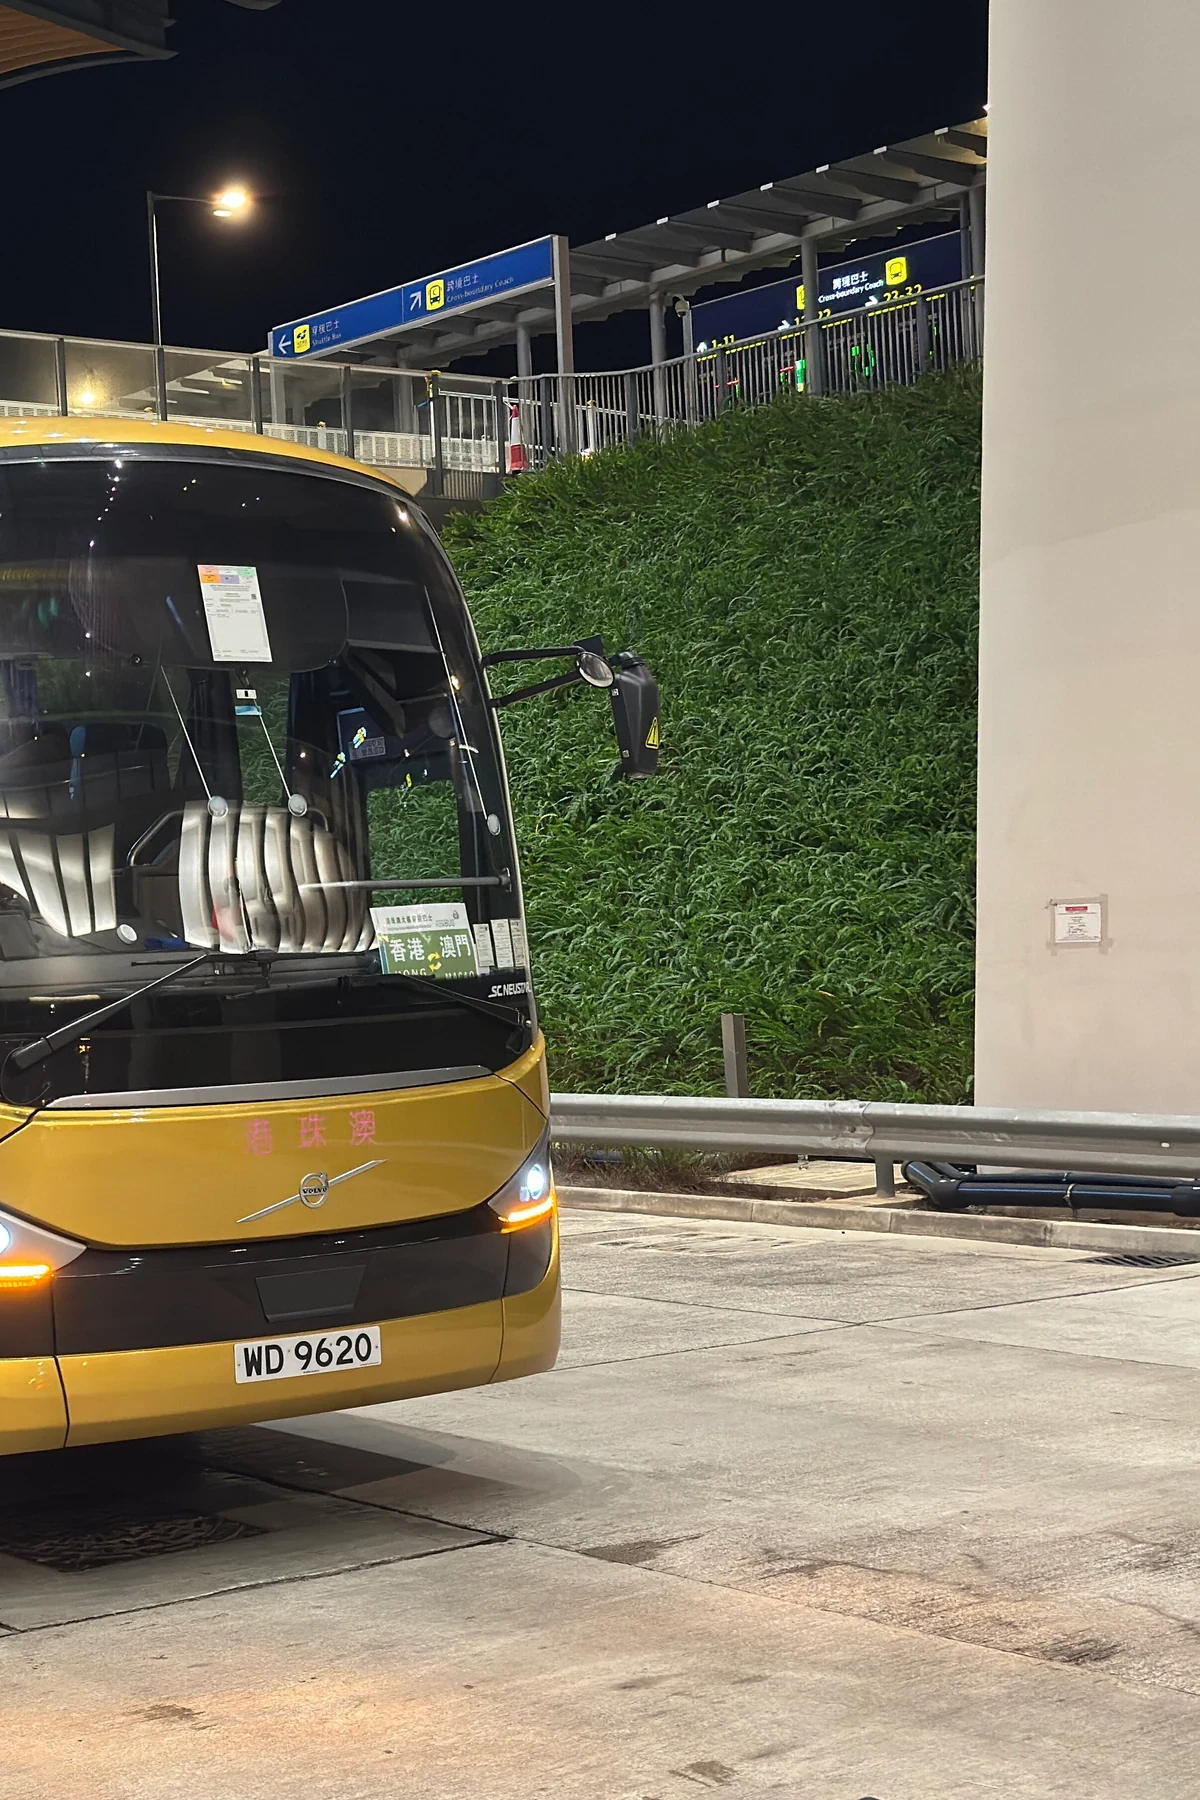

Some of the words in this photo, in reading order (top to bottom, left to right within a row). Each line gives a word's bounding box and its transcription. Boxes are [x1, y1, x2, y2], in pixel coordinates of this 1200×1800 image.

[446, 283, 493, 303] Cross-boundary
[494, 276, 514, 288] Coach
[818, 285, 865, 303] Cross-boundary
[864, 279, 884, 291] Coach
[312, 335, 331, 347] Shuttle
[331, 333, 342, 341] Bus
[389, 938, 425, 962] 香港
[439, 934, 472, 959] 澳門
[302, 1186, 328, 1195] VOLVO
[243, 1344, 284, 1377] WD
[294, 1333, 372, 1371] 9620
